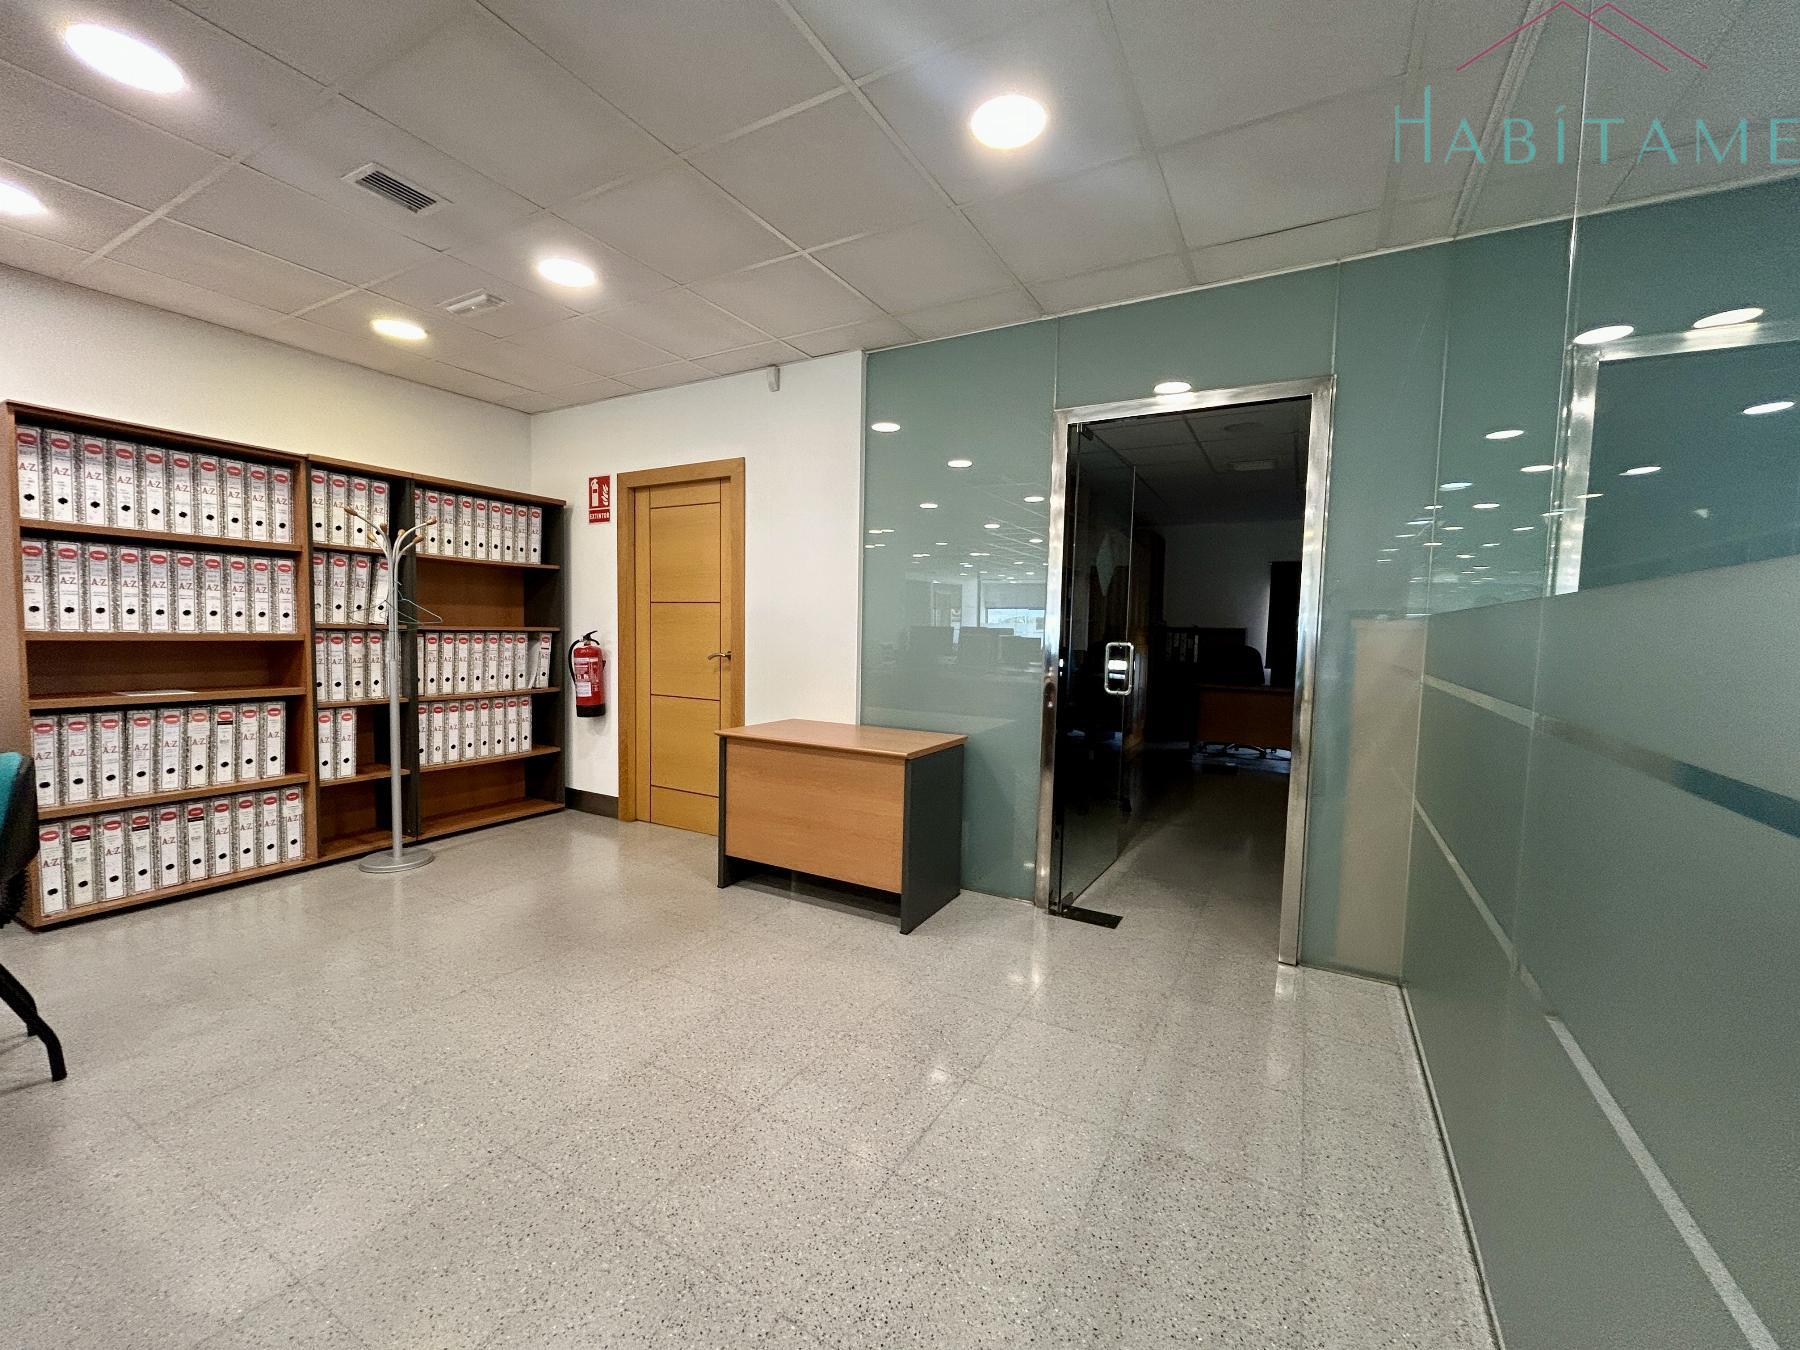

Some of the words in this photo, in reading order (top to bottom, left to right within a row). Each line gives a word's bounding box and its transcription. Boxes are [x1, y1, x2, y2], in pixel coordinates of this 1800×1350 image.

[19, 462, 36, 471] A-Z
[54, 467, 69, 476] A-Z
[87, 472, 102, 480] A-Z
[176, 484, 189, 492] A-Z
[106, 847, 121, 856] A-Z
[44, 858, 59, 868] A-Z
